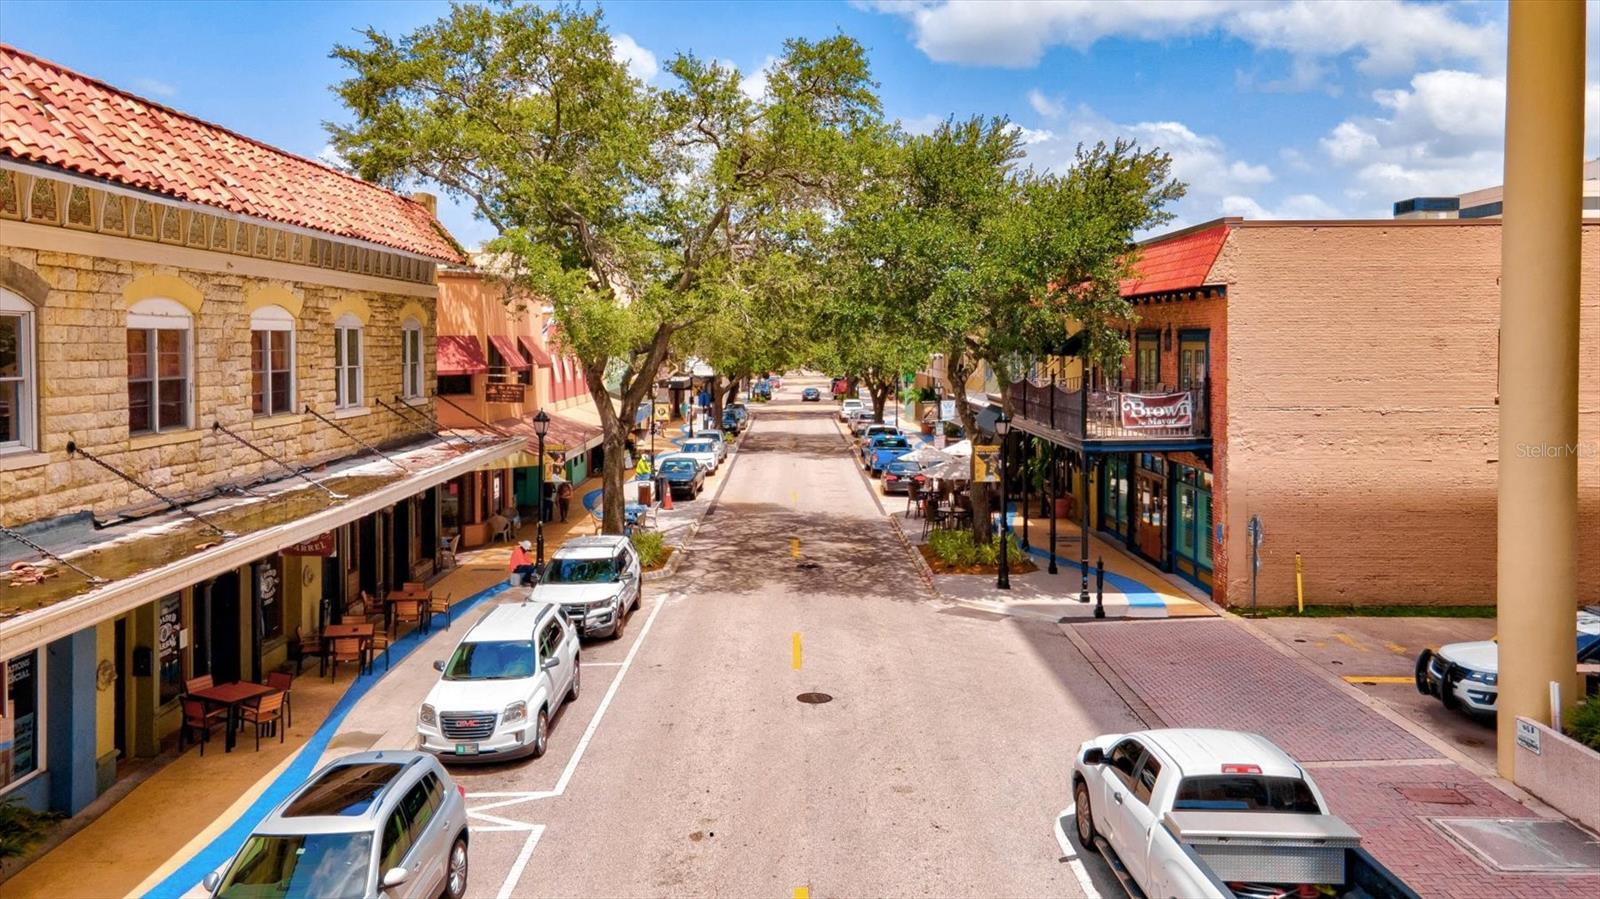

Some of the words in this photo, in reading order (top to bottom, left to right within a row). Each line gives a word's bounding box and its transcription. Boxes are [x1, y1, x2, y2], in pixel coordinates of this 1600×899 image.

[1122, 400, 1189, 417] Brown
[1147, 418, 1178, 426] Mayor
[291, 541, 327, 552] ARREL
[456, 719, 480, 728] GMC
